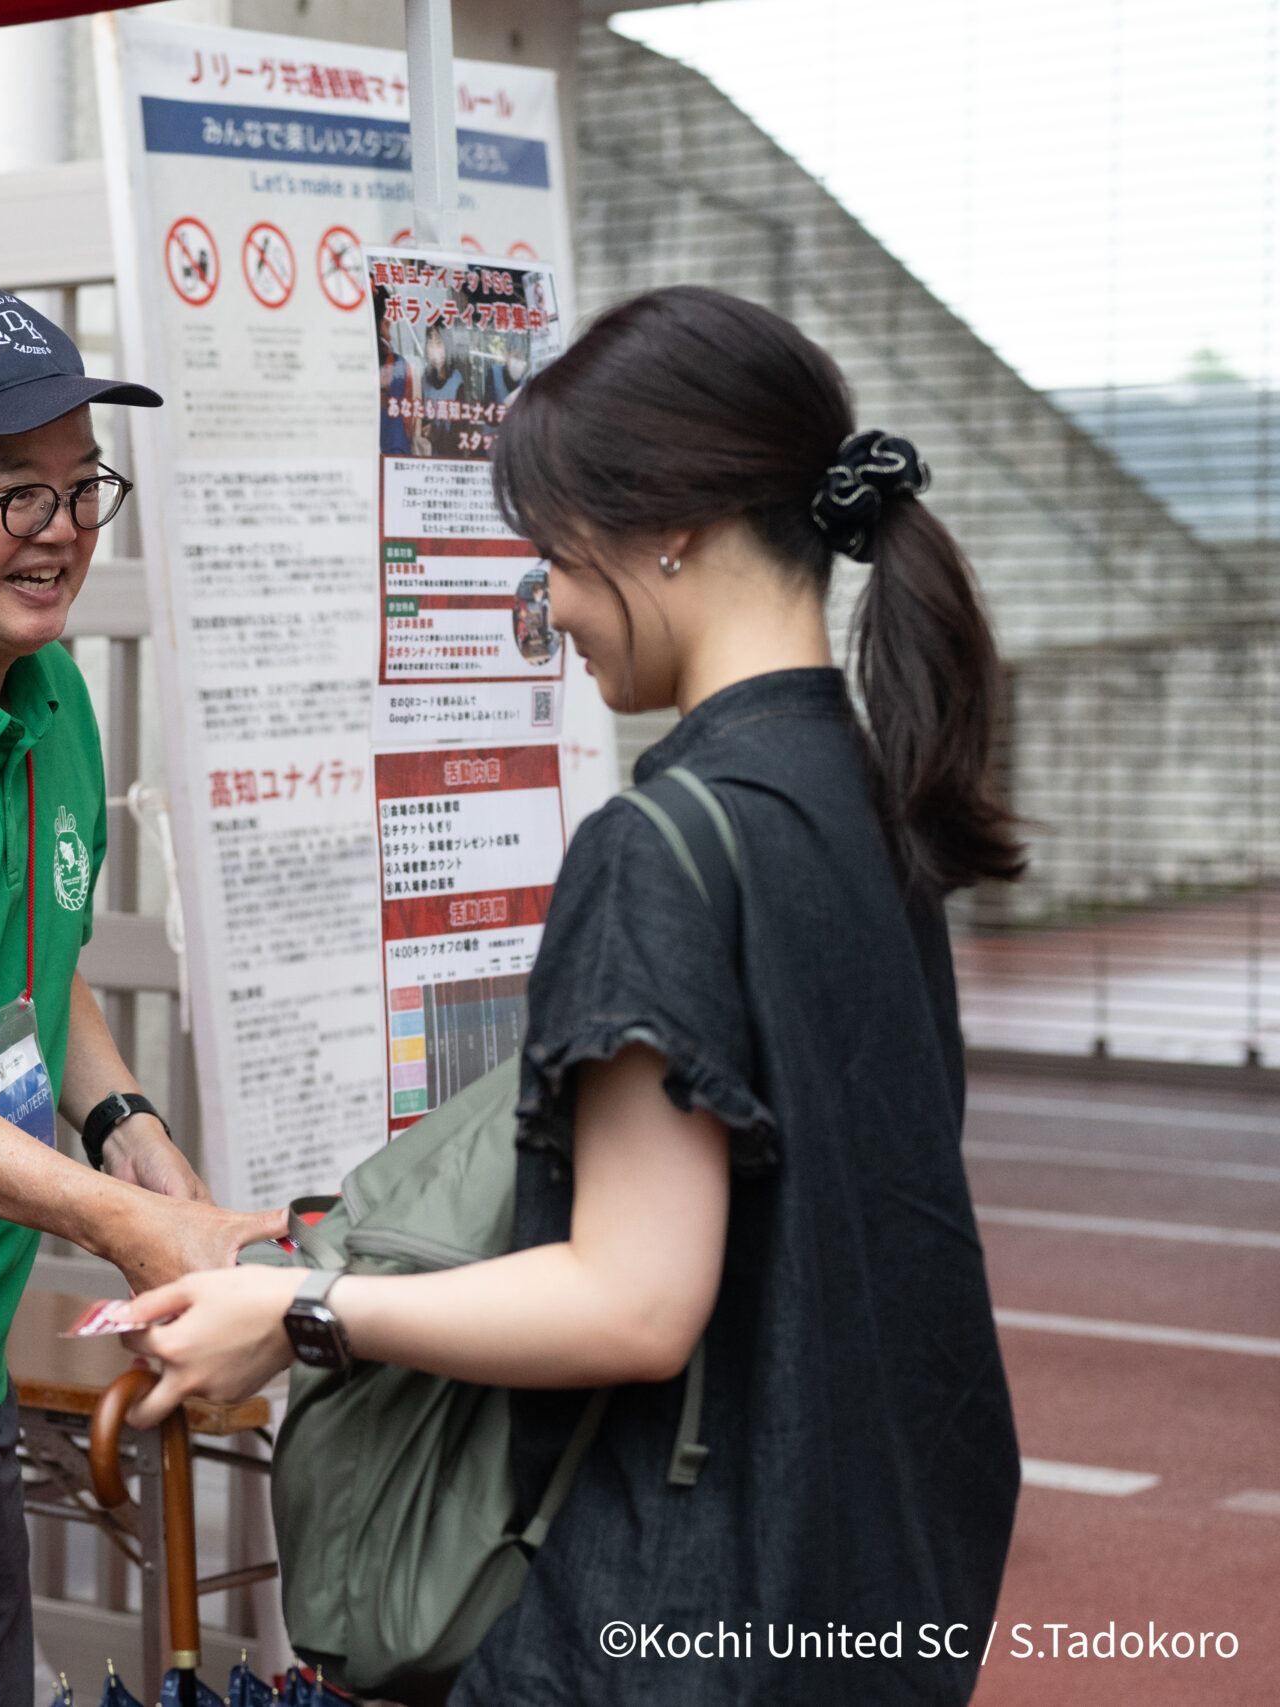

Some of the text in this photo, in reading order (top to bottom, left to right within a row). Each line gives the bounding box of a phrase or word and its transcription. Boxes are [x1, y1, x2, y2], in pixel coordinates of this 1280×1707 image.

[373, 262, 514, 296] 高知ユナイテッドSC
[458, 431, 499, 450] スタッ
[444, 758, 500, 786] 活動内容
[389, 937, 480, 960] 14:00キックオフの場合
